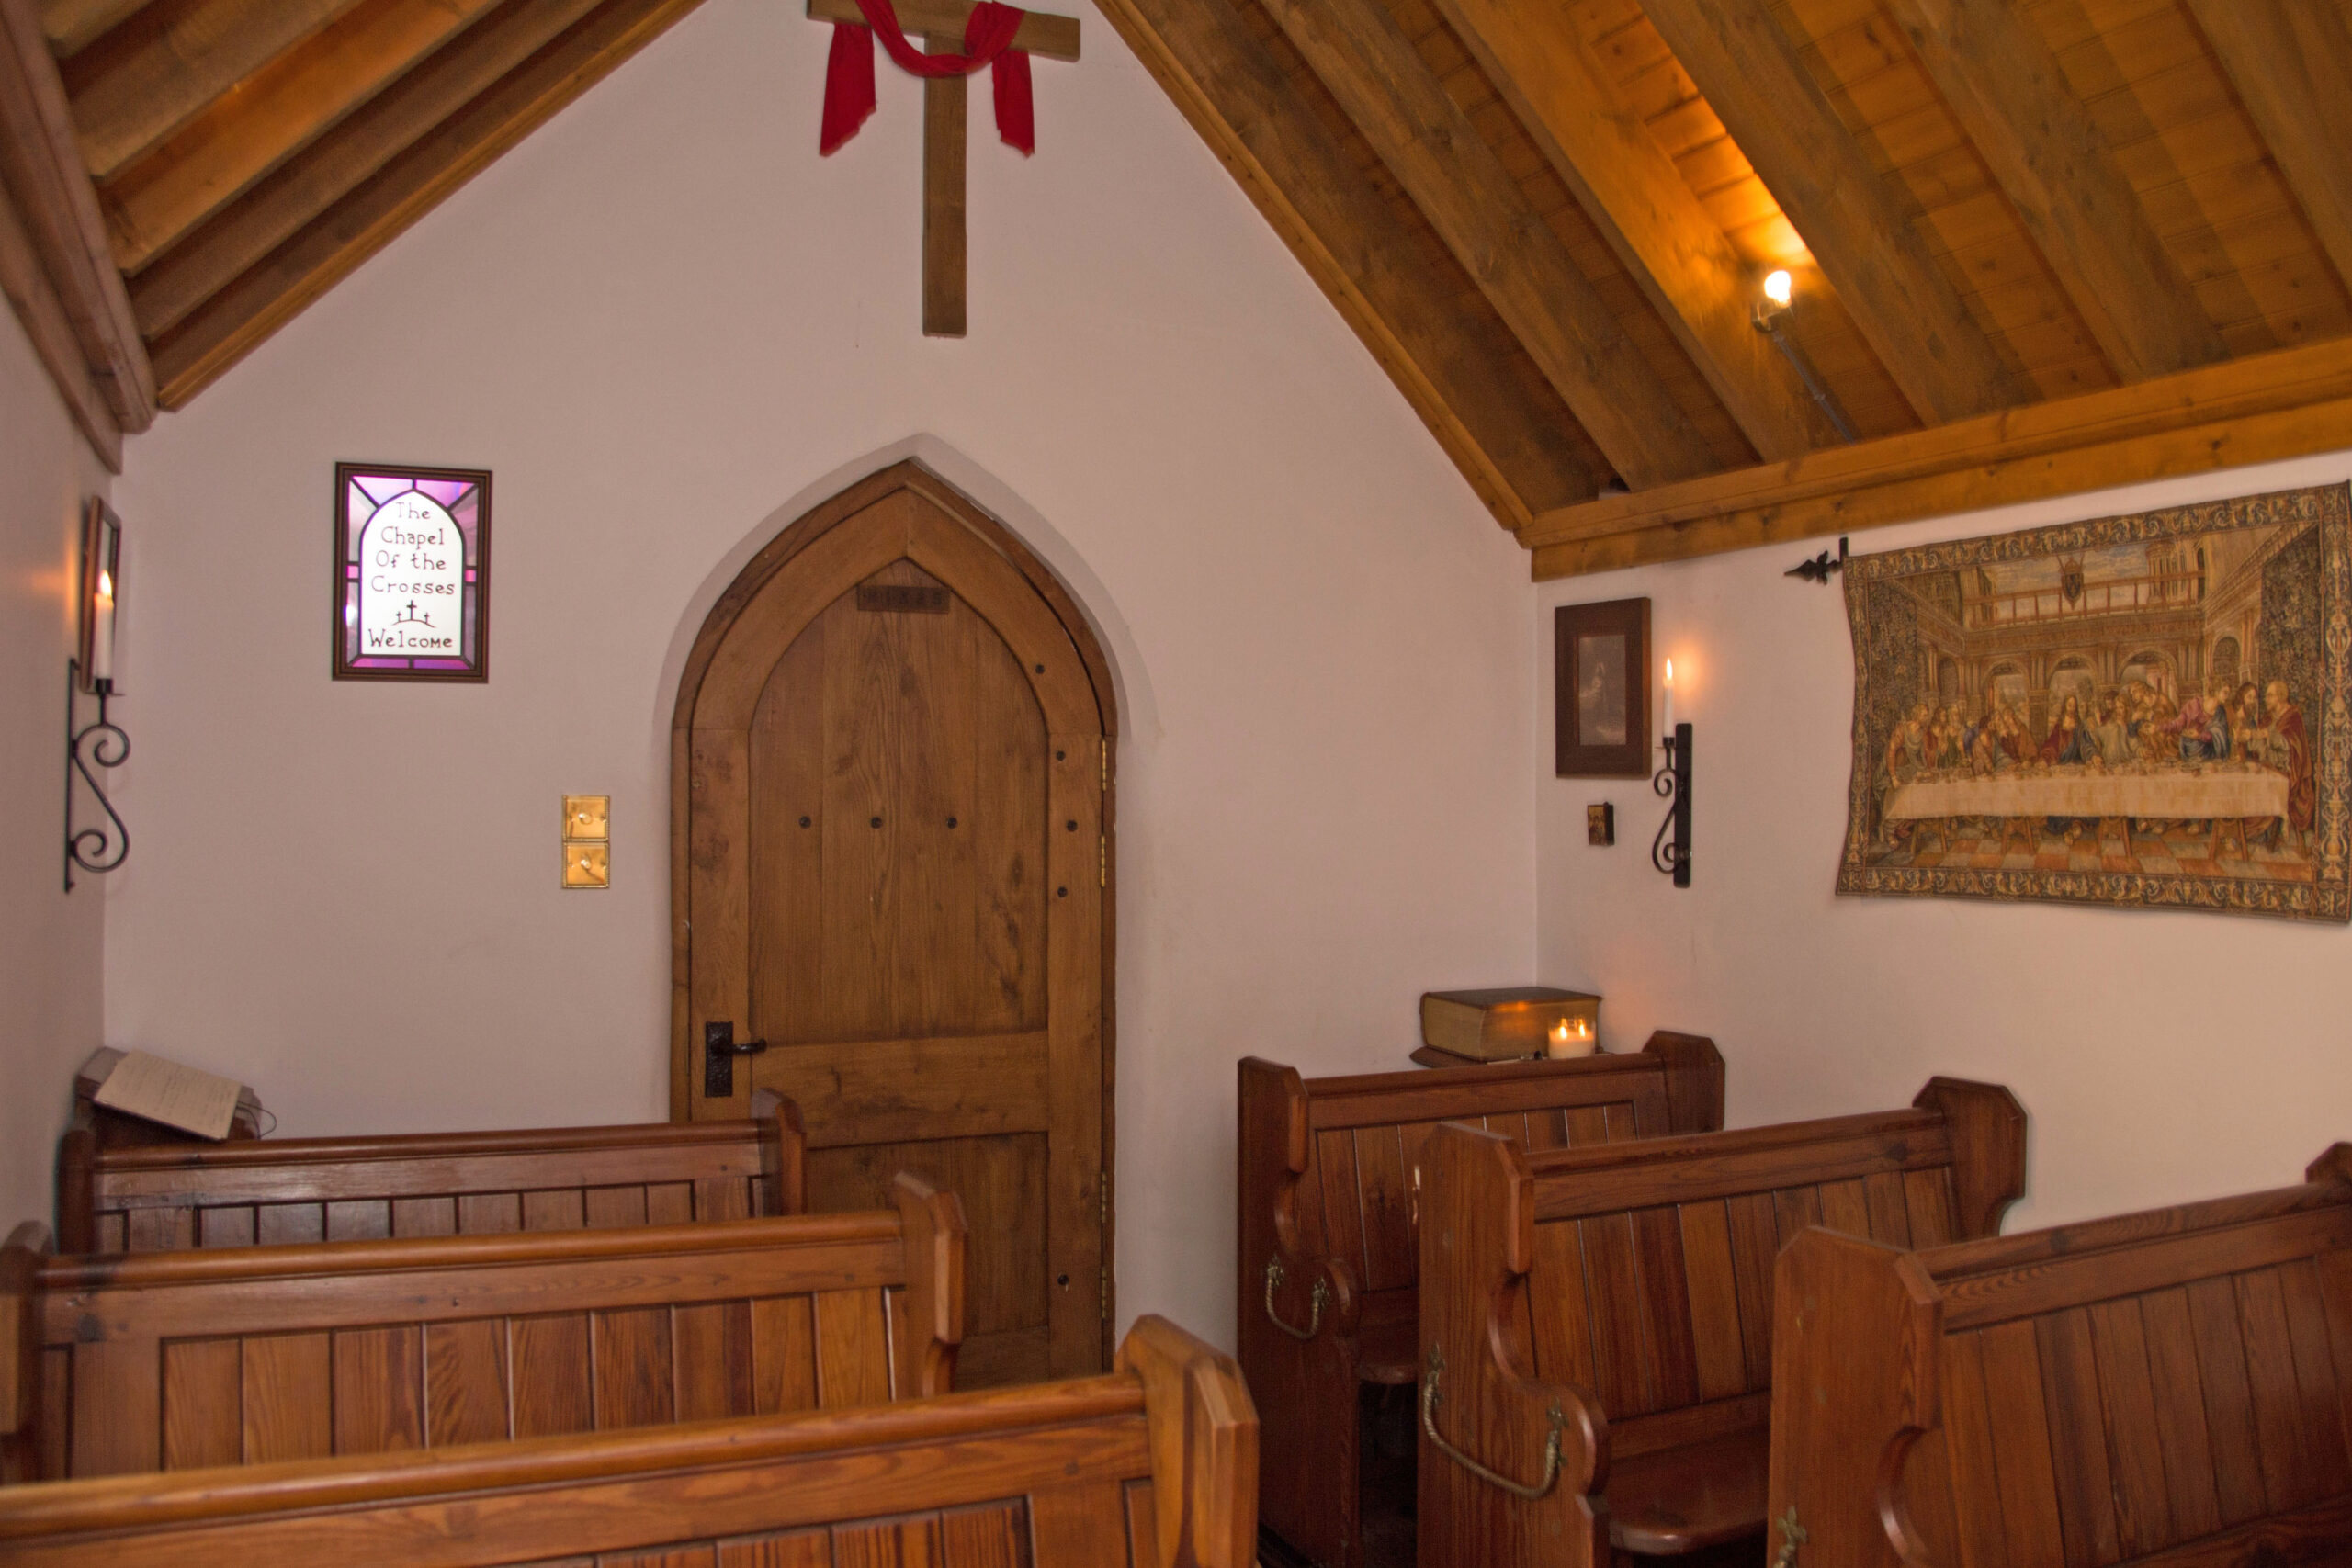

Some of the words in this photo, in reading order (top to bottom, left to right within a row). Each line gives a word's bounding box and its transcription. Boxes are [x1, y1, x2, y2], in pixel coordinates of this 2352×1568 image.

[396, 502, 431, 520] The
[381, 525, 445, 550] Chapel
[376, 549, 401, 568] Of
[411, 553, 447, 570] the
[371, 575, 456, 595] Crosses
